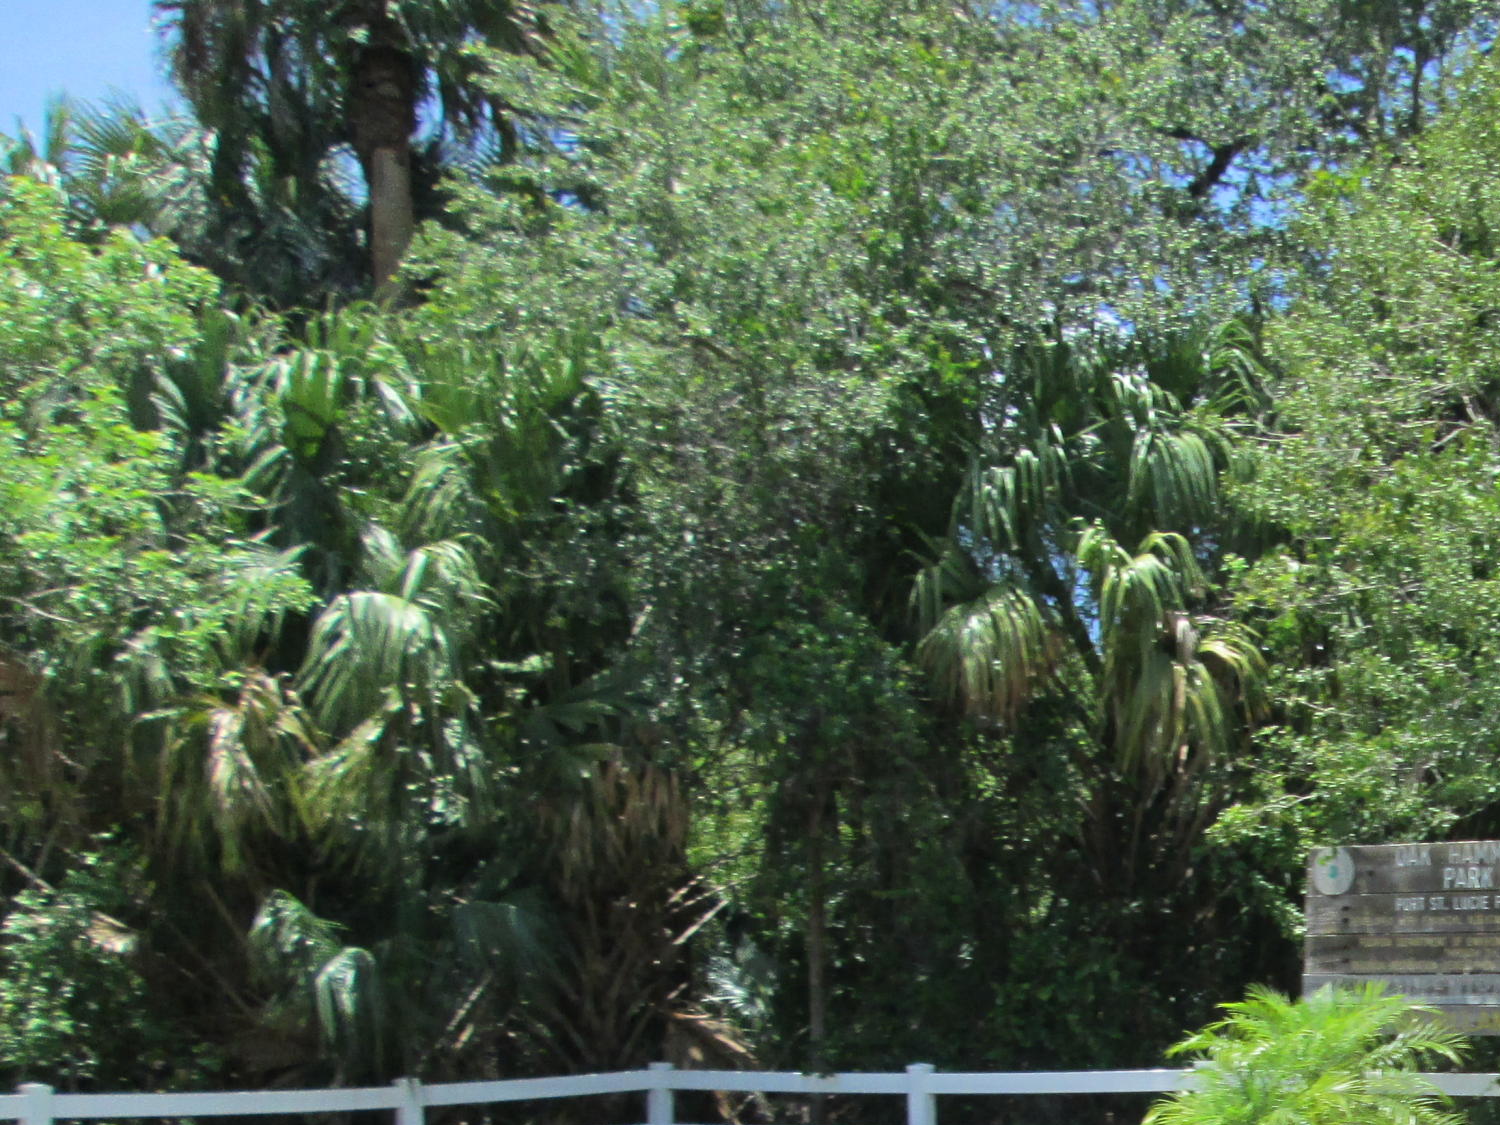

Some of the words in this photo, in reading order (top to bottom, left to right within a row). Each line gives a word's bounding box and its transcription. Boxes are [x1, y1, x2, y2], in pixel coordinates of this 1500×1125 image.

[1442, 866, 1494, 889] PARK
[1394, 897, 1425, 912] PORT
[1452, 895, 1491, 911] LUCIE
